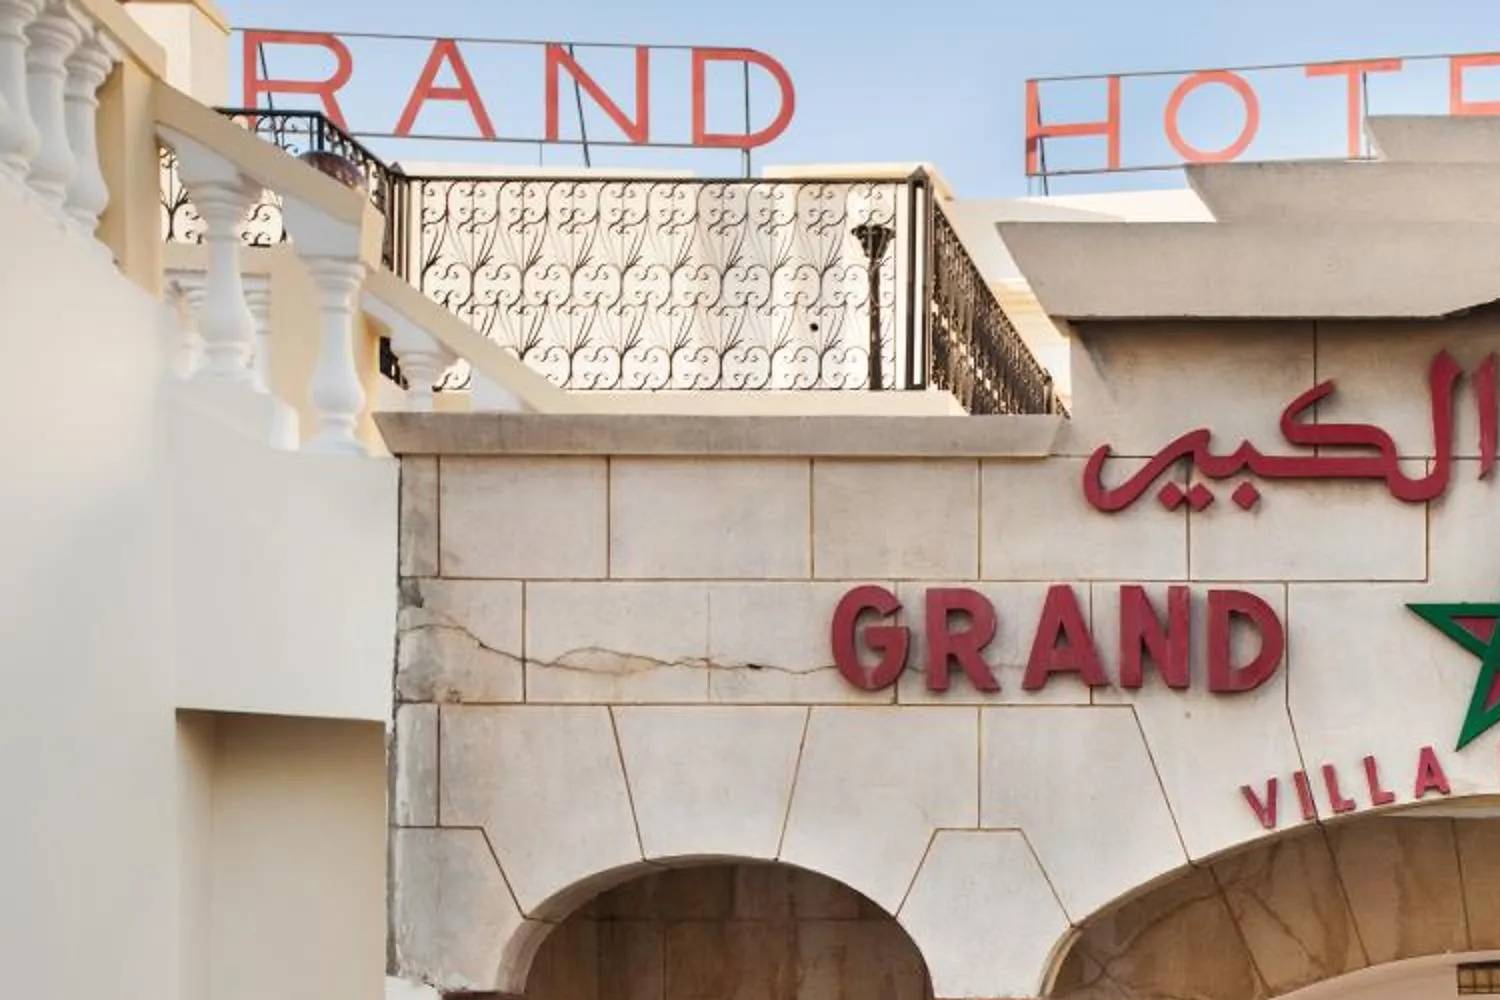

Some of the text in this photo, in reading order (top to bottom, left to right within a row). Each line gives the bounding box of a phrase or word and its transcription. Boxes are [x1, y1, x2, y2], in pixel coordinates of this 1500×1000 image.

[1083, 348, 1500, 512] الكبير
[831, 584, 1286, 694] GRAND
[1241, 746, 1451, 829] VILLA
